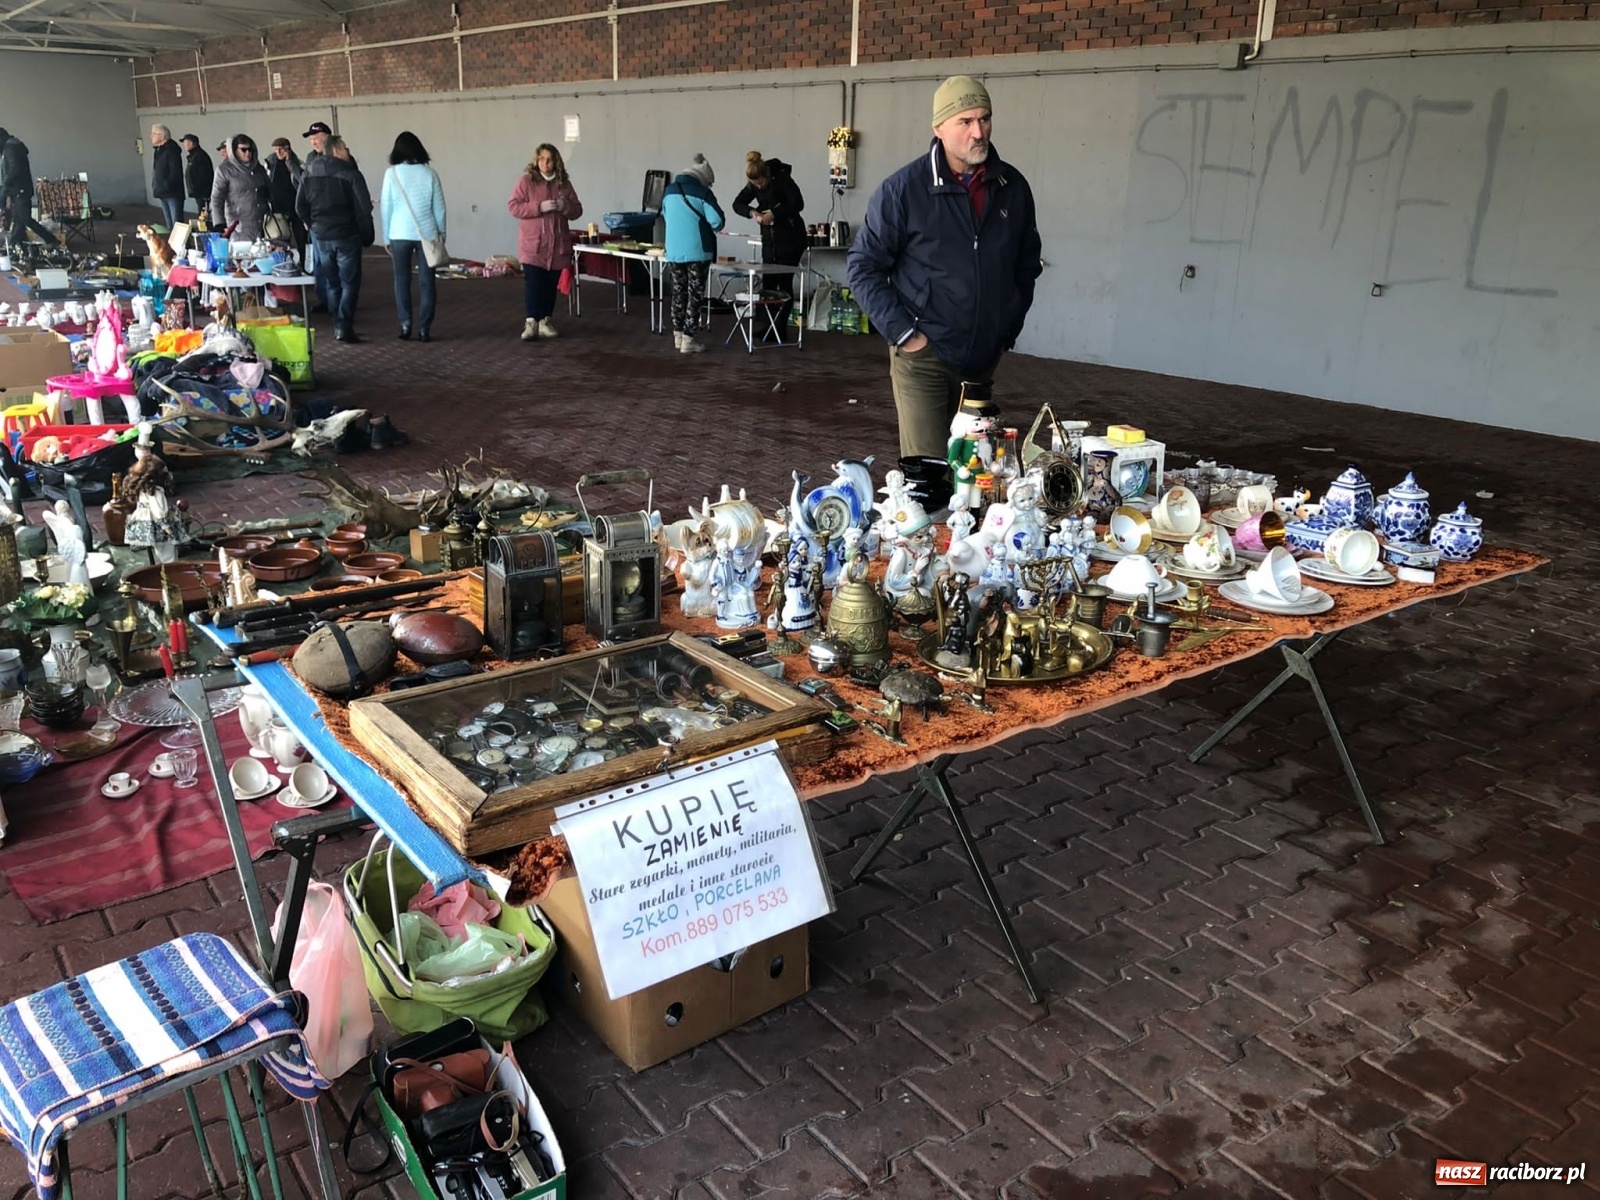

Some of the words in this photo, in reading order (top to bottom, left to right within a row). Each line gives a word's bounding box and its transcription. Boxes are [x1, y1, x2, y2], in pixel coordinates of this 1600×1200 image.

[612, 780, 757, 849] KUPIĘ
[644, 813, 744, 866] ZAMIENIĘ
[589, 881, 626, 905] Stare
[630, 861, 684, 890] zegarki,
[687, 844, 737, 870] monety,
[740, 823, 796, 852] militaria,
[639, 888, 686, 911] medale
[690, 880, 694, 893] i
[699, 872, 726, 889] inne
[731, 853, 774, 878] starocie
[622, 904, 680, 940] SZKŁO
[694, 865, 781, 909] PORCELANA
[723, 899, 754, 925] 075
[758, 887, 789, 912] 533
